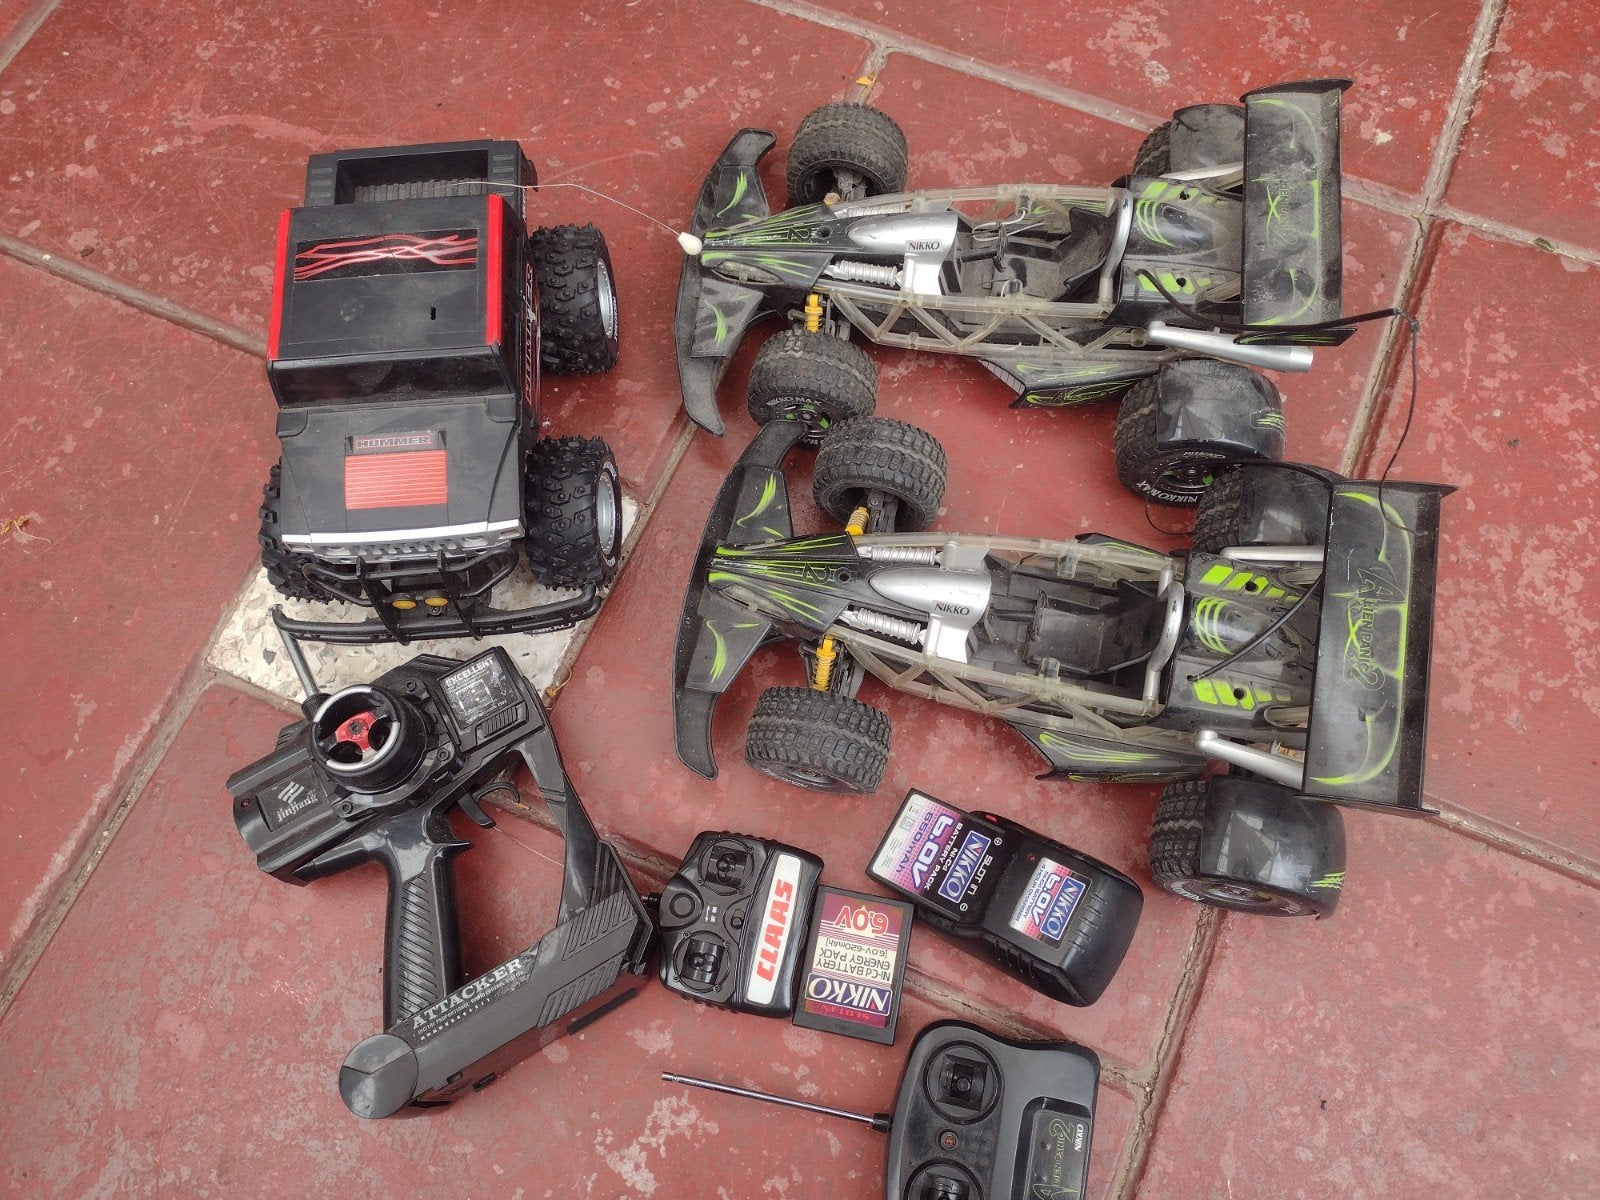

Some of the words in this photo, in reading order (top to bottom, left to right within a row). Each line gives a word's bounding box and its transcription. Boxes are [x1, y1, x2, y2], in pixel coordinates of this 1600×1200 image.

[908, 240, 942, 251] NIKKO
[355, 435, 432, 449] HUMMER
[934, 601, 971, 616] NIKKO
[445, 656, 495, 688] EXCELLENT
[896, 811, 933, 873] 650mAh
[939, 822, 963, 864] BATTERY
[923, 865, 941, 890] PACK
[945, 835, 984, 898] NIKKO
[976, 854, 993, 883] SLOT
[834, 905, 889, 935] 6.0V
[1047, 880, 1079, 935] NIKKO
[756, 878, 794, 982] CLAAS
[815, 957, 865, 975] BATTERY
[819, 947, 848, 961] PACK
[849, 955, 891, 970] ENERGY
[413, 958, 522, 1030] ATTACK-ER
[808, 977, 890, 1012] NIKKO
[1074, 1123, 1084, 1152] NIKKO
